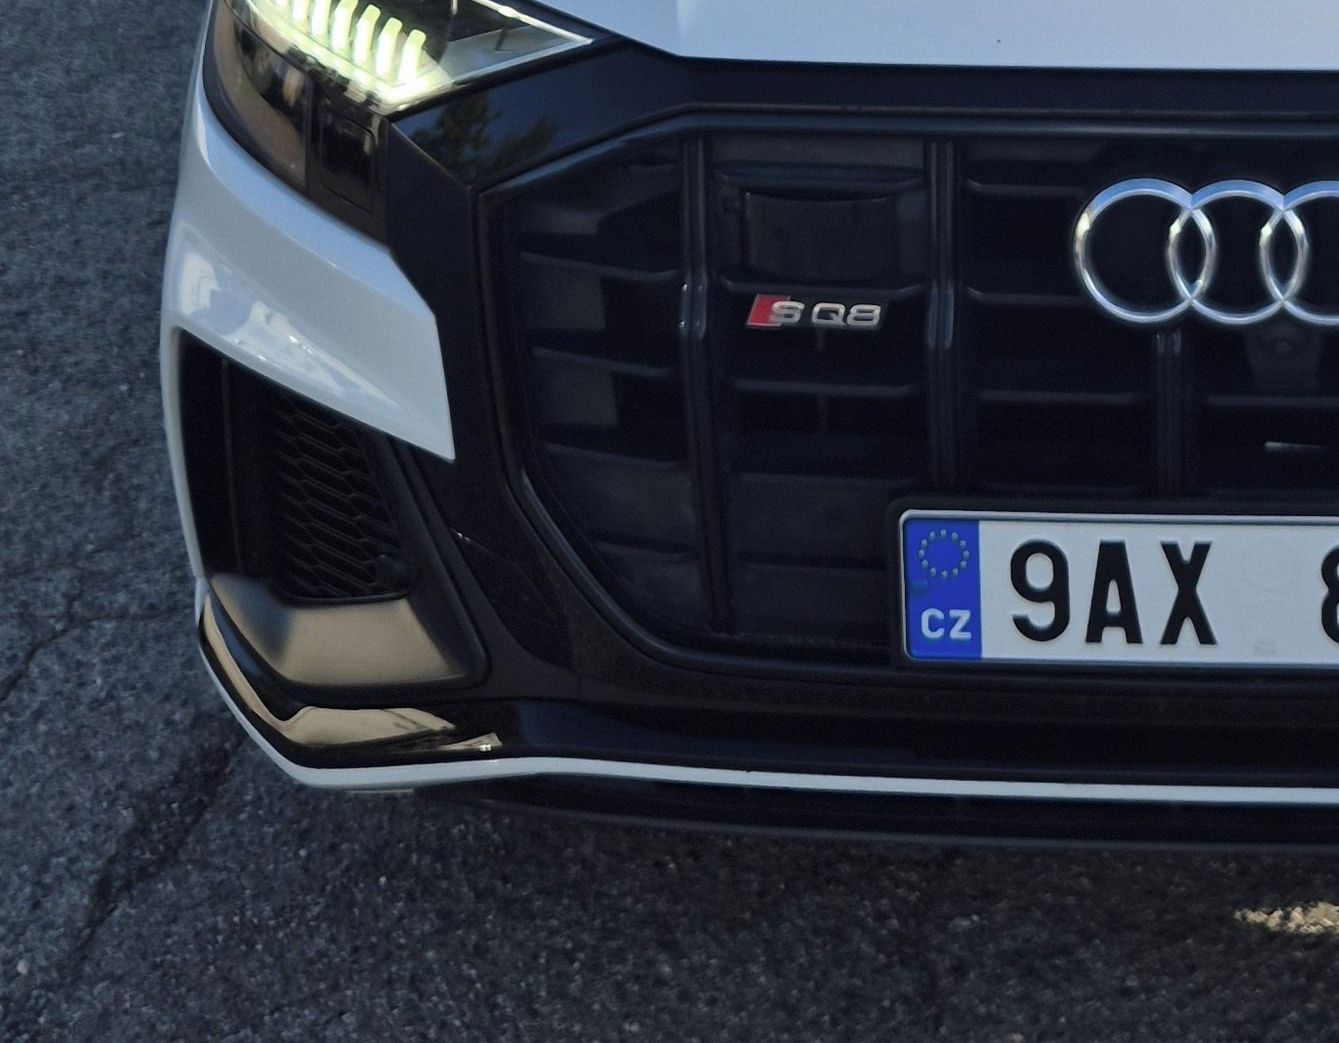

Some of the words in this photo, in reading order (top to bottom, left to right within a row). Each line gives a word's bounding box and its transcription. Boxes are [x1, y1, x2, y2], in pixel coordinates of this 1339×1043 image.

[768, 300, 881, 326] SQ8
[1010, 539, 1218, 645] 9AX
[920, 608, 973, 640] CZ
